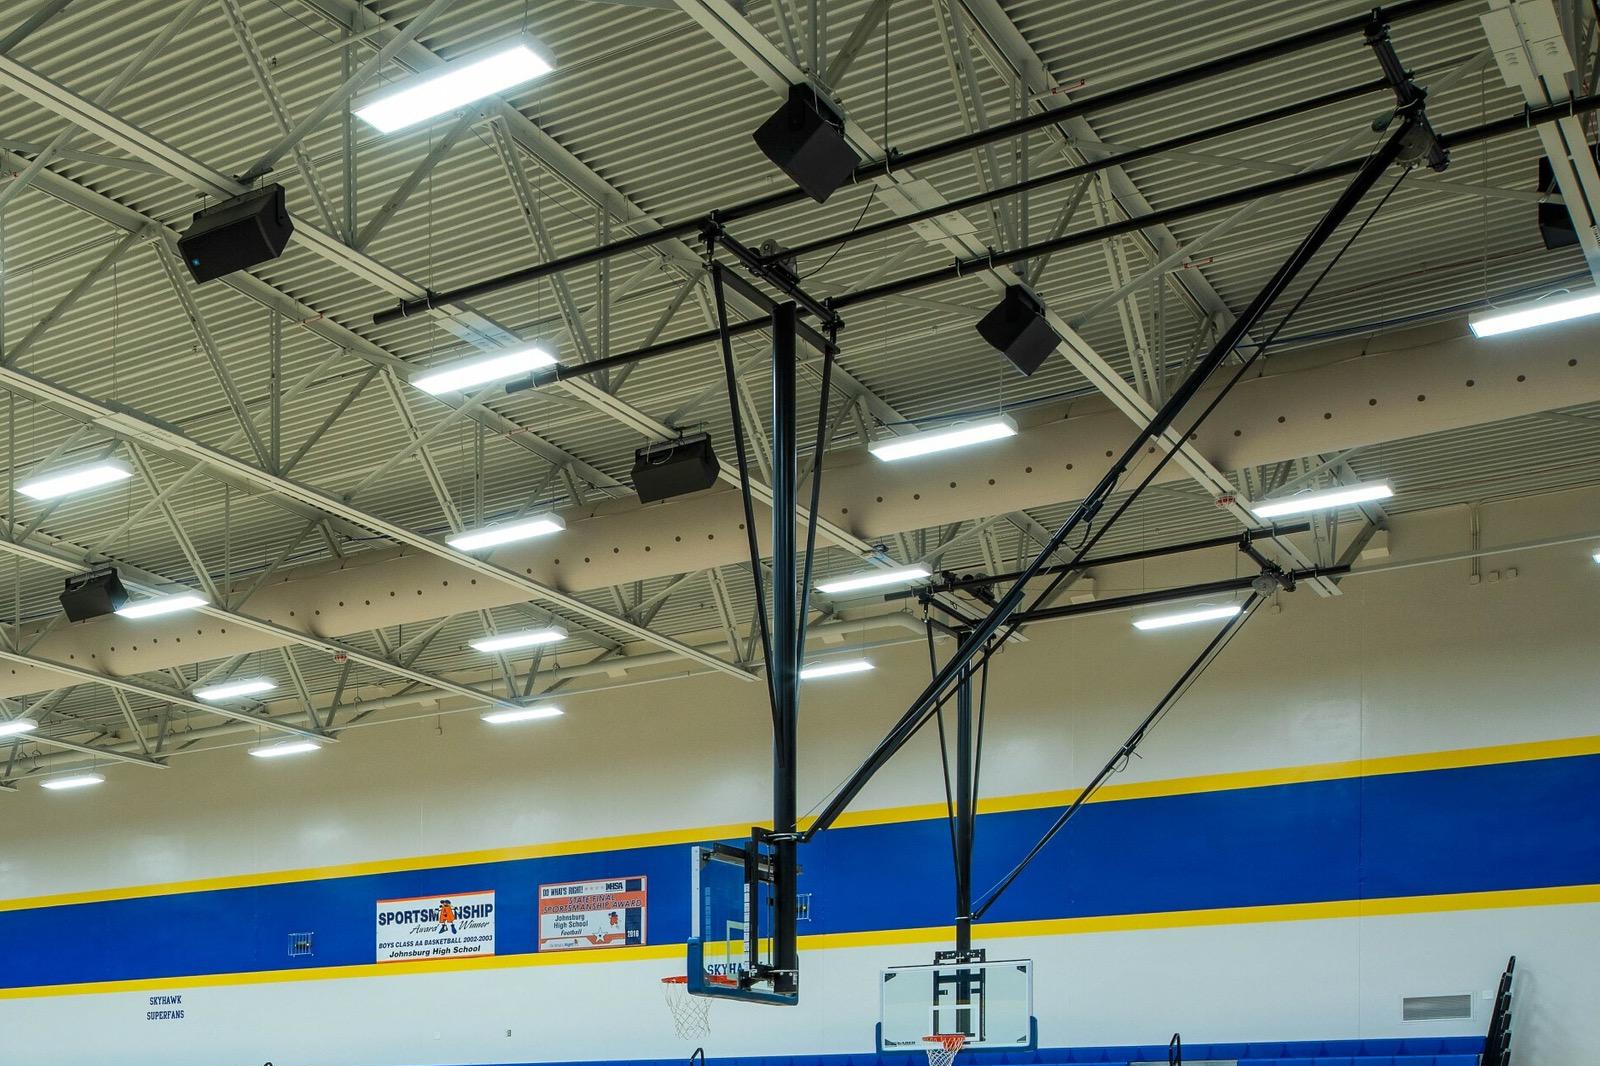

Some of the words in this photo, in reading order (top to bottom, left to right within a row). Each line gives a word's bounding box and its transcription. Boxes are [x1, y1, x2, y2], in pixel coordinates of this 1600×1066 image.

[569, 896, 589, 904] STATE
[592, 894, 615, 902] FINAL
[544, 902, 609, 913] SPORTSMANSHIP
[613, 899, 641, 908] AWARD
[555, 914, 585, 922] Johnsburg
[409, 923, 438, 934] Award
[458, 920, 490, 931] Winner
[568, 920, 588, 928] School
[424, 938, 462, 946] BASKETBALL
[463, 934, 493, 943] 2002-2003
[389, 949, 430, 958] Johnsburg
[433, 947, 451, 957] High
[453, 945, 481, 953] School
[150, 995, 182, 1005] SKYHAWK
[147, 1010, 184, 1020] SUPERFANS
